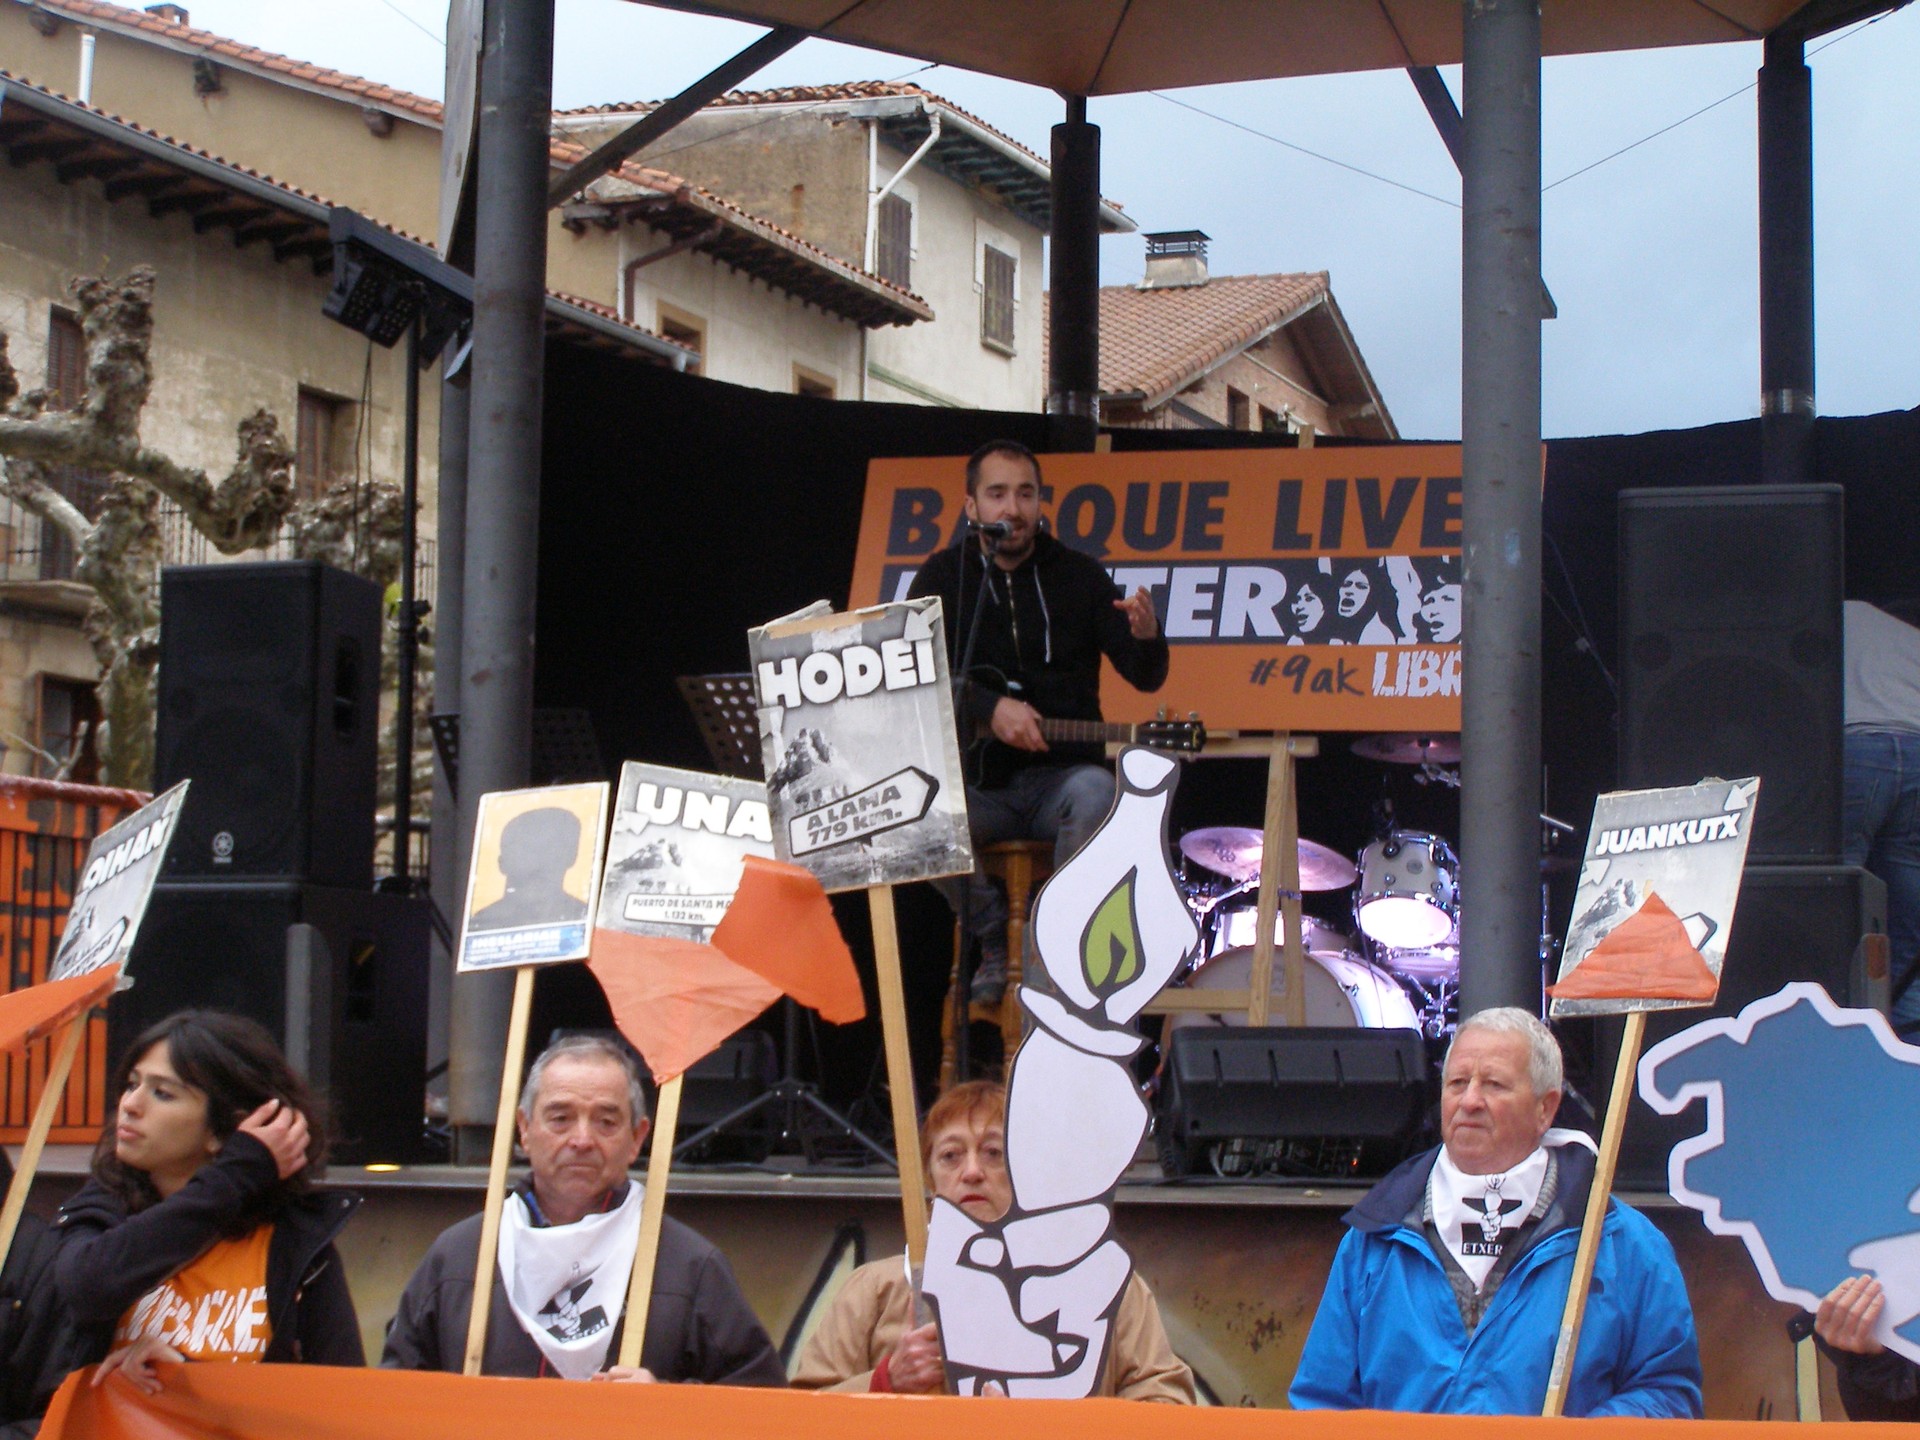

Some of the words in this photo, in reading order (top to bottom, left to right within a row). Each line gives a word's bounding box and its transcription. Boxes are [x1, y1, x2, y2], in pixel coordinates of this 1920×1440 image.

[887, 480, 1229, 555] BQUE
[1272, 477, 1462, 550] LIVE
[757, 637, 937, 709] HODEI
[1250, 654, 1365, 696] #9ak
[1371, 650, 1462, 697] LIBR
[636, 782, 773, 843] UNA
[808, 822, 848, 845] 779
[1595, 812, 1741, 856] JUANKUTX
[632, 898, 665, 907] PUERTO
[667, 899, 678, 908] DE
[681, 899, 713, 909] SANTA
[1463, 1242, 1503, 1255] ETXER
[118, 1284, 268, 1354] IBRE
